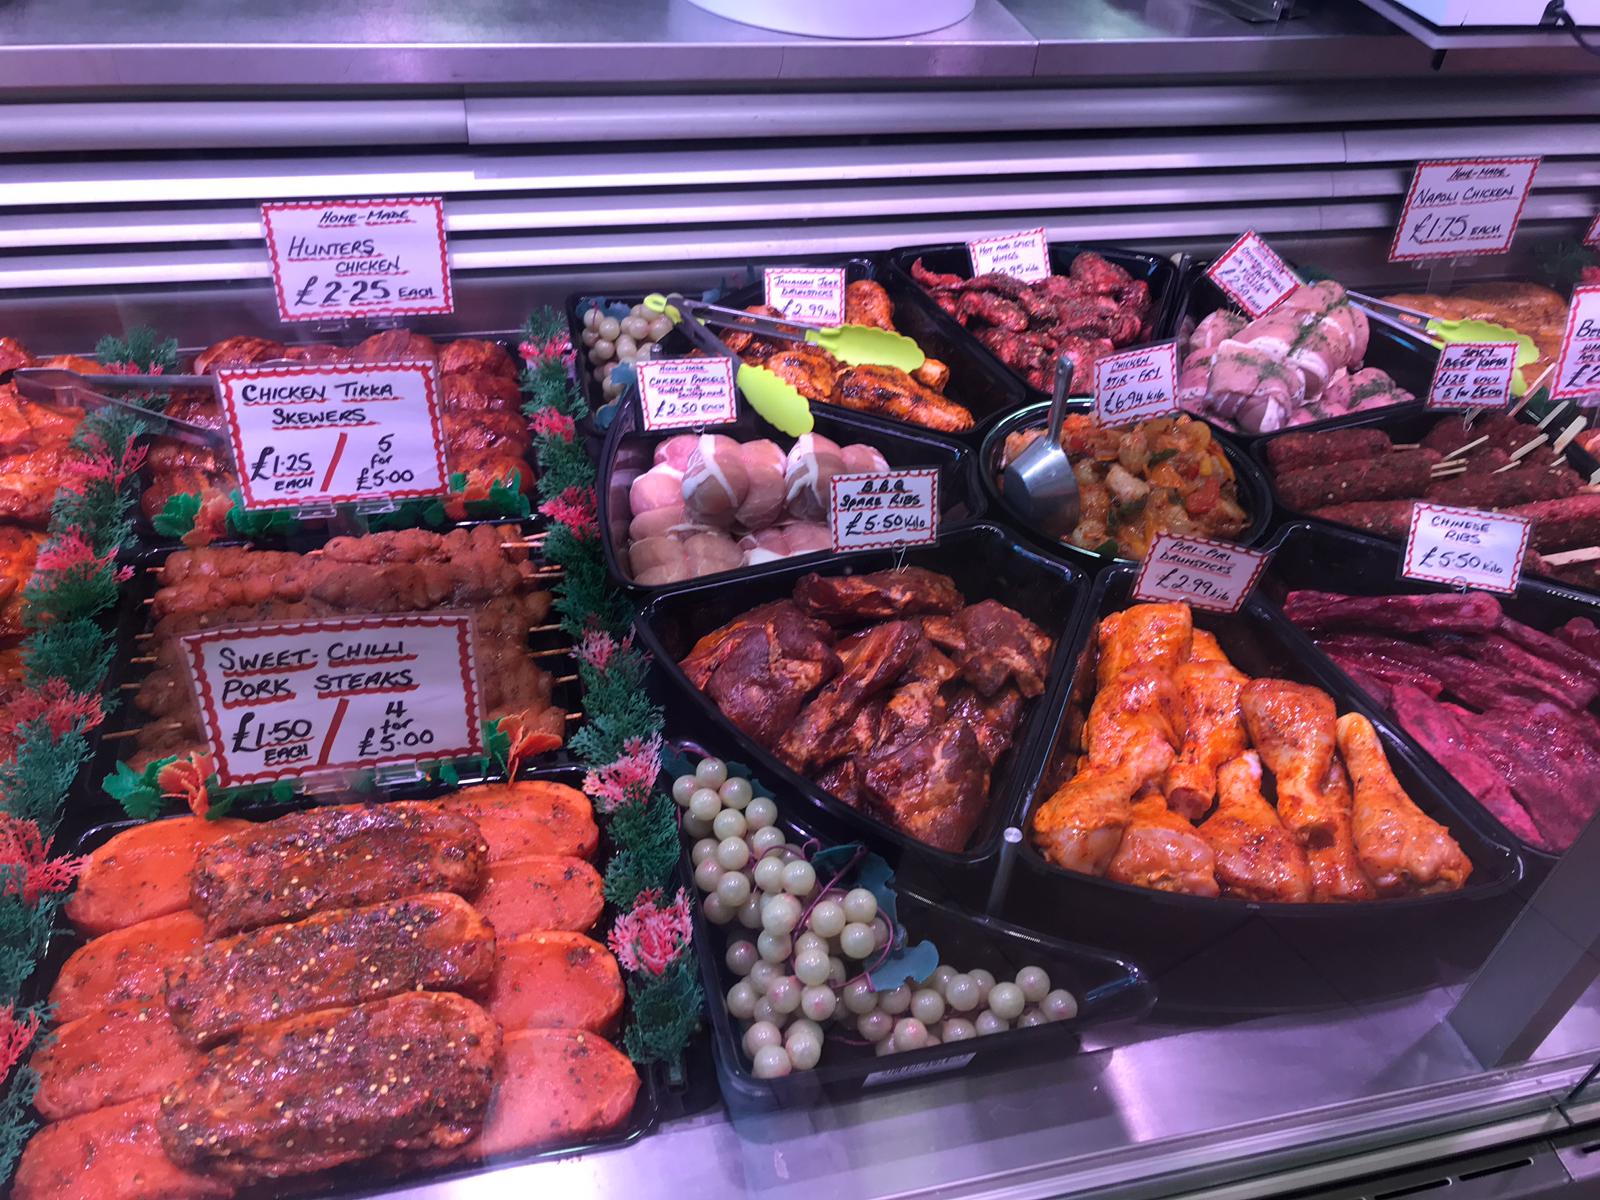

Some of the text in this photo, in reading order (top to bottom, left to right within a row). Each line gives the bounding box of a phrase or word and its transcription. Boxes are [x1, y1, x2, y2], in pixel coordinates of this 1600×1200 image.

[1412, 185, 1514, 204] NAPOLI CHICKEN
[320, 210, 409, 224] HOME-MADE
[1408, 213, 1501, 244] £1.75 EACH
[288, 236, 375, 257] HUNTERS
[335, 255, 400, 274] CHICKEN
[398, 287, 433, 299] EACH
[1112, 355, 1150, 369] CHICKEN
[242, 381, 393, 402] CHICKEN TIKKA
[272, 408, 366, 425] SKEWERS
[378, 433, 395, 452] 5
[250, 446, 312, 481] £1.25
[370, 454, 393, 469] for
[274, 477, 313, 491] EACH
[357, 467, 414, 491] £5.00
[840, 494, 920, 511] SPARE RIBS
[846, 512, 925, 536] £5.50 Kilo
[1431, 516, 1490, 532] CHINESE
[1445, 530, 1480, 544] RIBS
[1160, 552, 1232, 574] DRUMSTICKS
[1419, 546, 1481, 568] £5.50
[1155, 568, 1213, 595] £2.99
[328, 641, 403, 661] CHILLI
[222, 669, 413, 700] PORK STEAKS
[385, 701, 408, 718] 4
[232, 712, 312, 753] £1.50
[381, 718, 413, 734] for
[358, 728, 434, 757] £5.00
[264, 744, 308, 762] EACH
